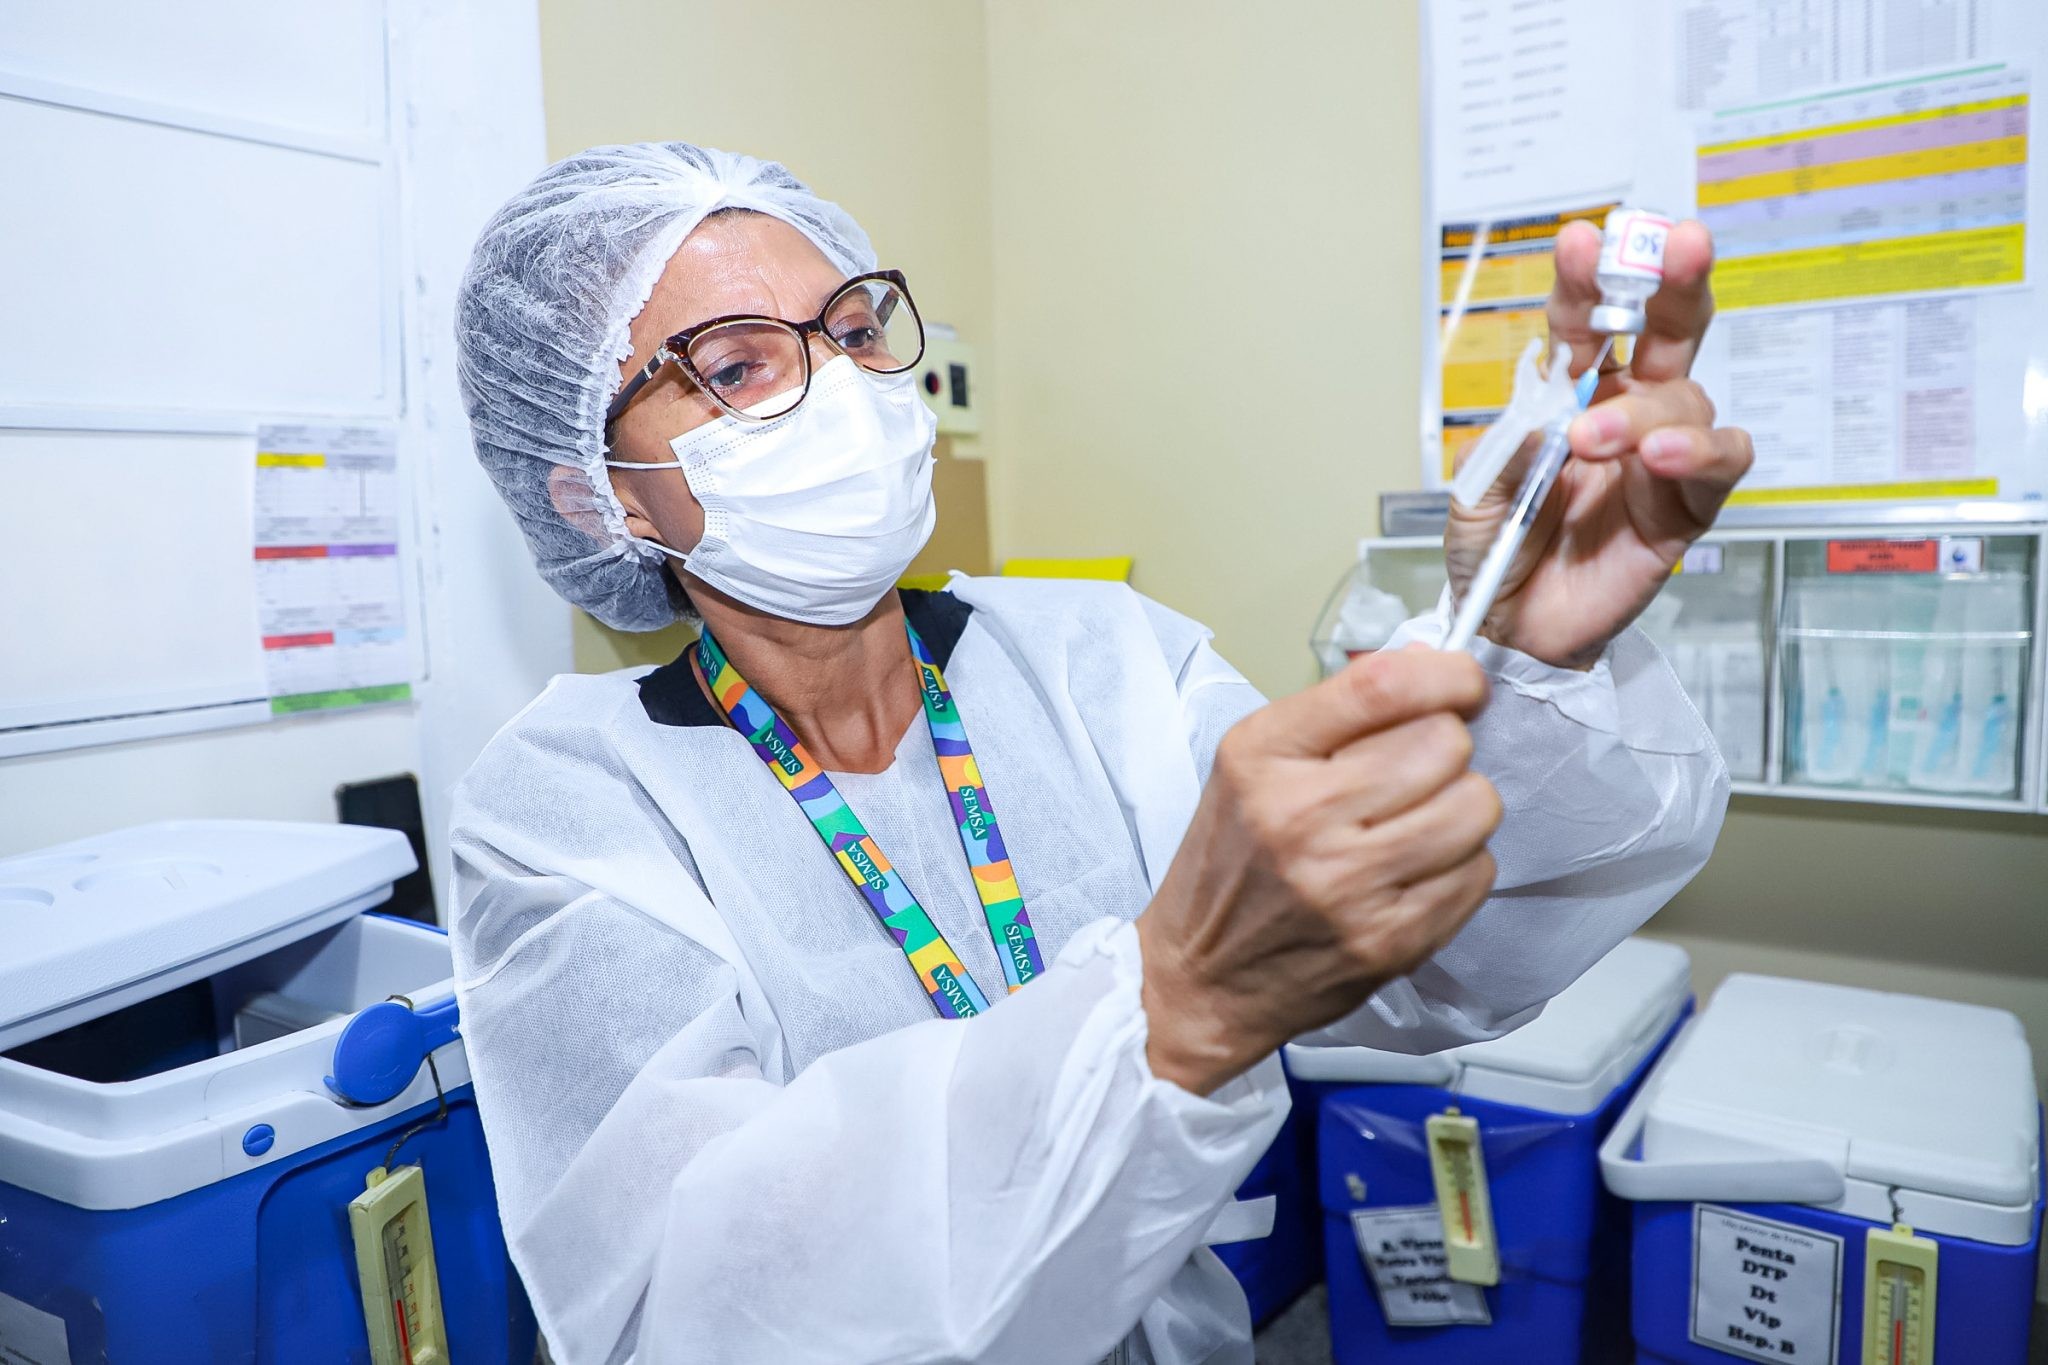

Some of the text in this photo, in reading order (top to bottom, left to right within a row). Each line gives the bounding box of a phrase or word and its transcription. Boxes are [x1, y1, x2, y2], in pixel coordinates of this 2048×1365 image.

[924, 669, 944, 709] SEMSA
[765, 731, 801, 774] SEMSA
[961, 787, 985, 837] SEMSA
[849, 842, 886, 890] SEMSA
[1007, 925, 1032, 981] SEMSA
[937, 967, 976, 1018] SEMSA
[1736, 1238, 1795, 1265] Penta
[1743, 1259, 1788, 1281] DTP
[1750, 1285, 1777, 1303] Dt
[1780, 1340, 1796, 1355] B
